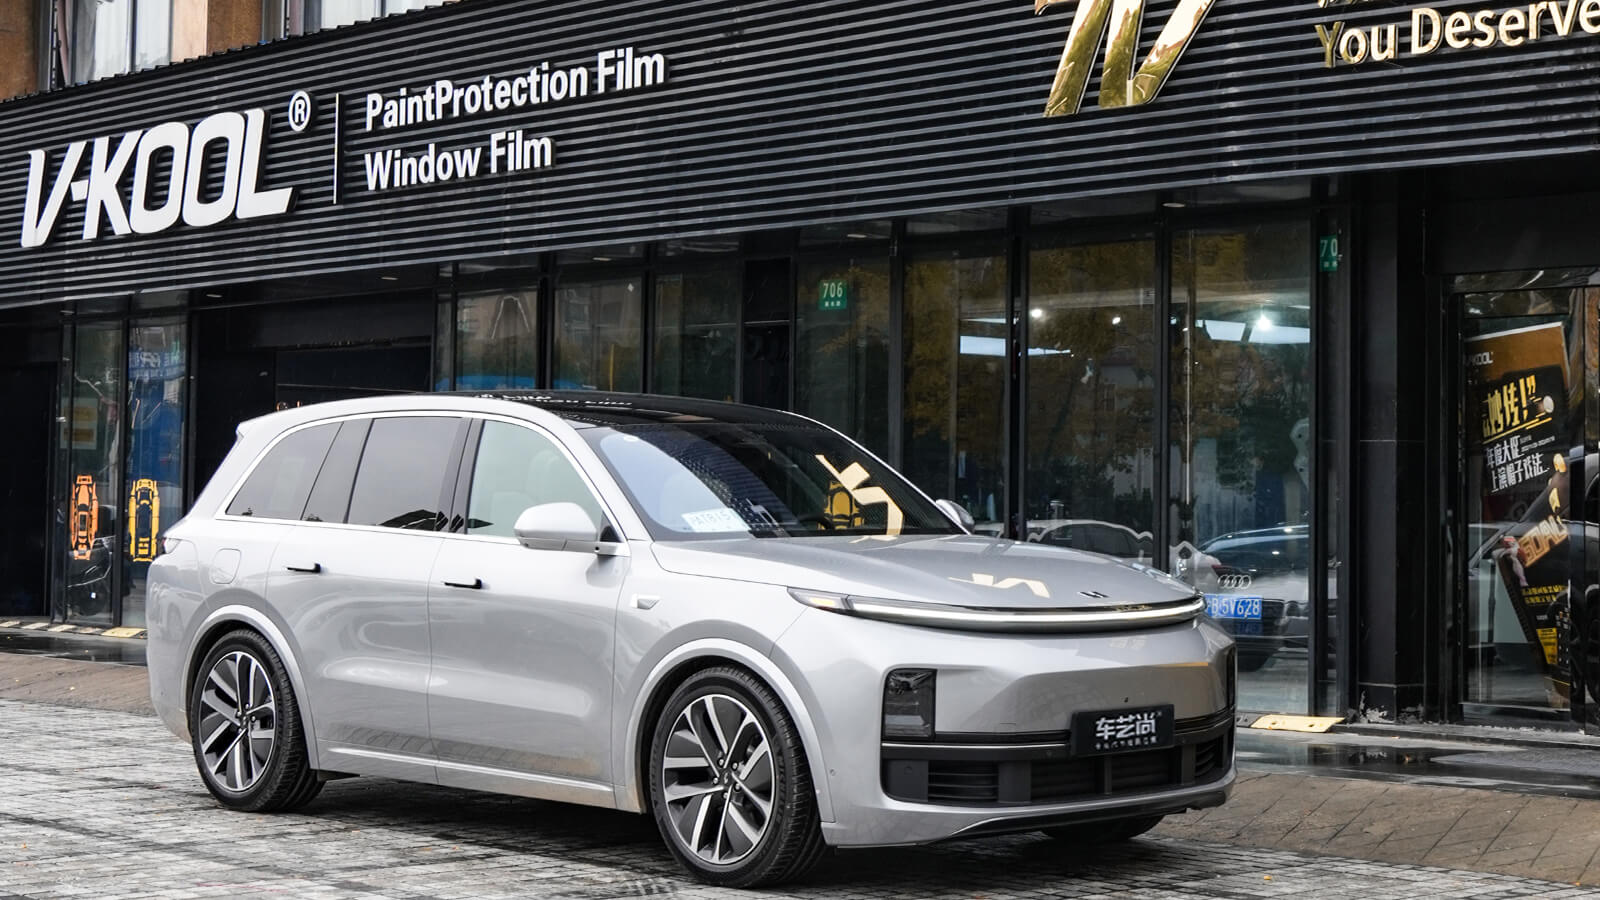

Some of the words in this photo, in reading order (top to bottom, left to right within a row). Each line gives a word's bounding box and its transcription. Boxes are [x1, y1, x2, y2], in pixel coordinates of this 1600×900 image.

[1315, 22, 1397, 68] You
[1410, 0, 1600, 54] Deserve
[366, 61, 588, 132] PaintProtection
[597, 46, 665, 94] Film
[20, 108, 293, 248] V-KOOL
[364, 143, 482, 191] Window
[490, 129, 553, 174] Film
[823, 282, 843, 299] 706
[1096, 711, 1156, 740] 车艺尚
